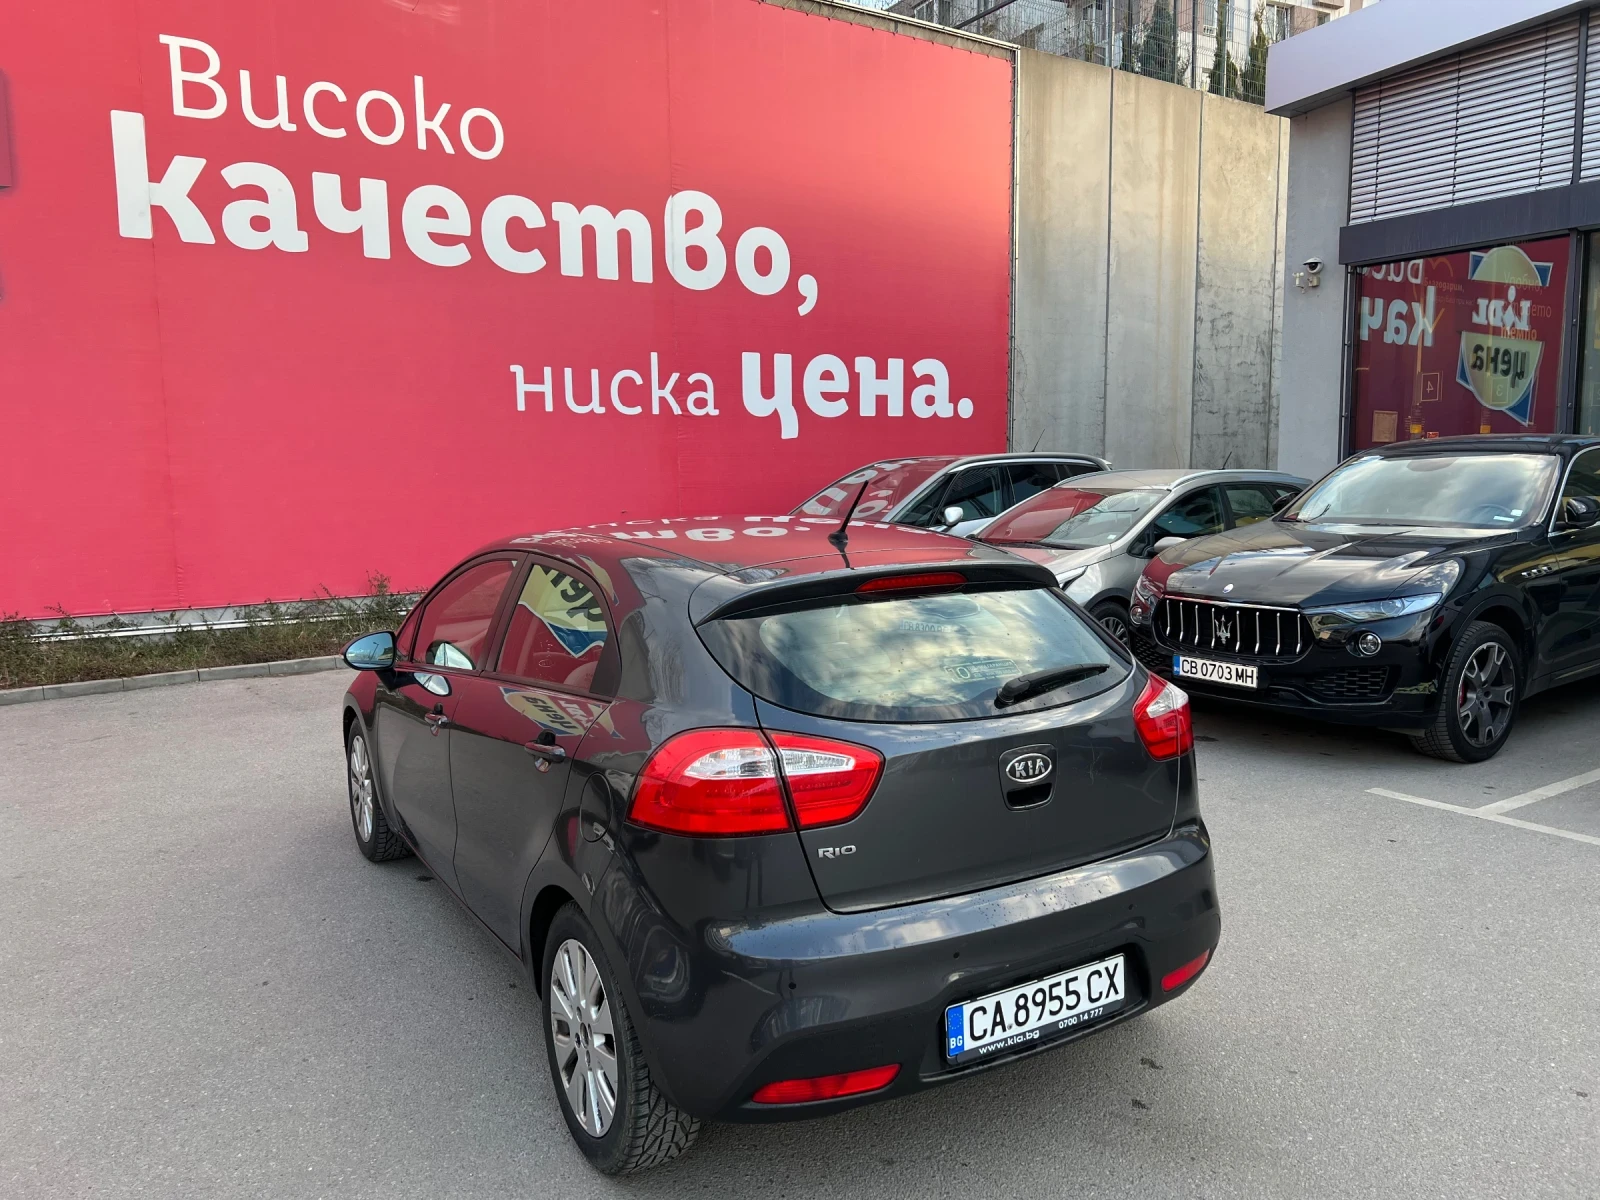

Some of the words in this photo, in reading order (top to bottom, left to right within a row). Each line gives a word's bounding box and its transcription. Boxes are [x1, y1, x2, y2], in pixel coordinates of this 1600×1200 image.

[159, 34, 504, 160] Високо
[110, 109, 818, 317] качество,
[509, 350, 720, 416] ниска
[741, 352, 974, 440] цена.
[1182, 659, 1198, 675] CB
[1201, 662, 1233, 681] 0703
[1235, 667, 1254, 685] MH
[1014, 758, 1046, 778] KIA
[817, 844, 857, 859] RIO
[969, 1000, 1008, 1041] CA
[1013, 976, 1081, 1027] 8955
[1086, 962, 1120, 1004] CX
[1058, 1016, 1078, 1029] 0700
[1079, 1013, 1089, 1022] 14
[1089, 1007, 1104, 1019] 777
[949, 1035, 963, 1049] BG
[978, 1029, 1041, 1056] www.kia.bg
